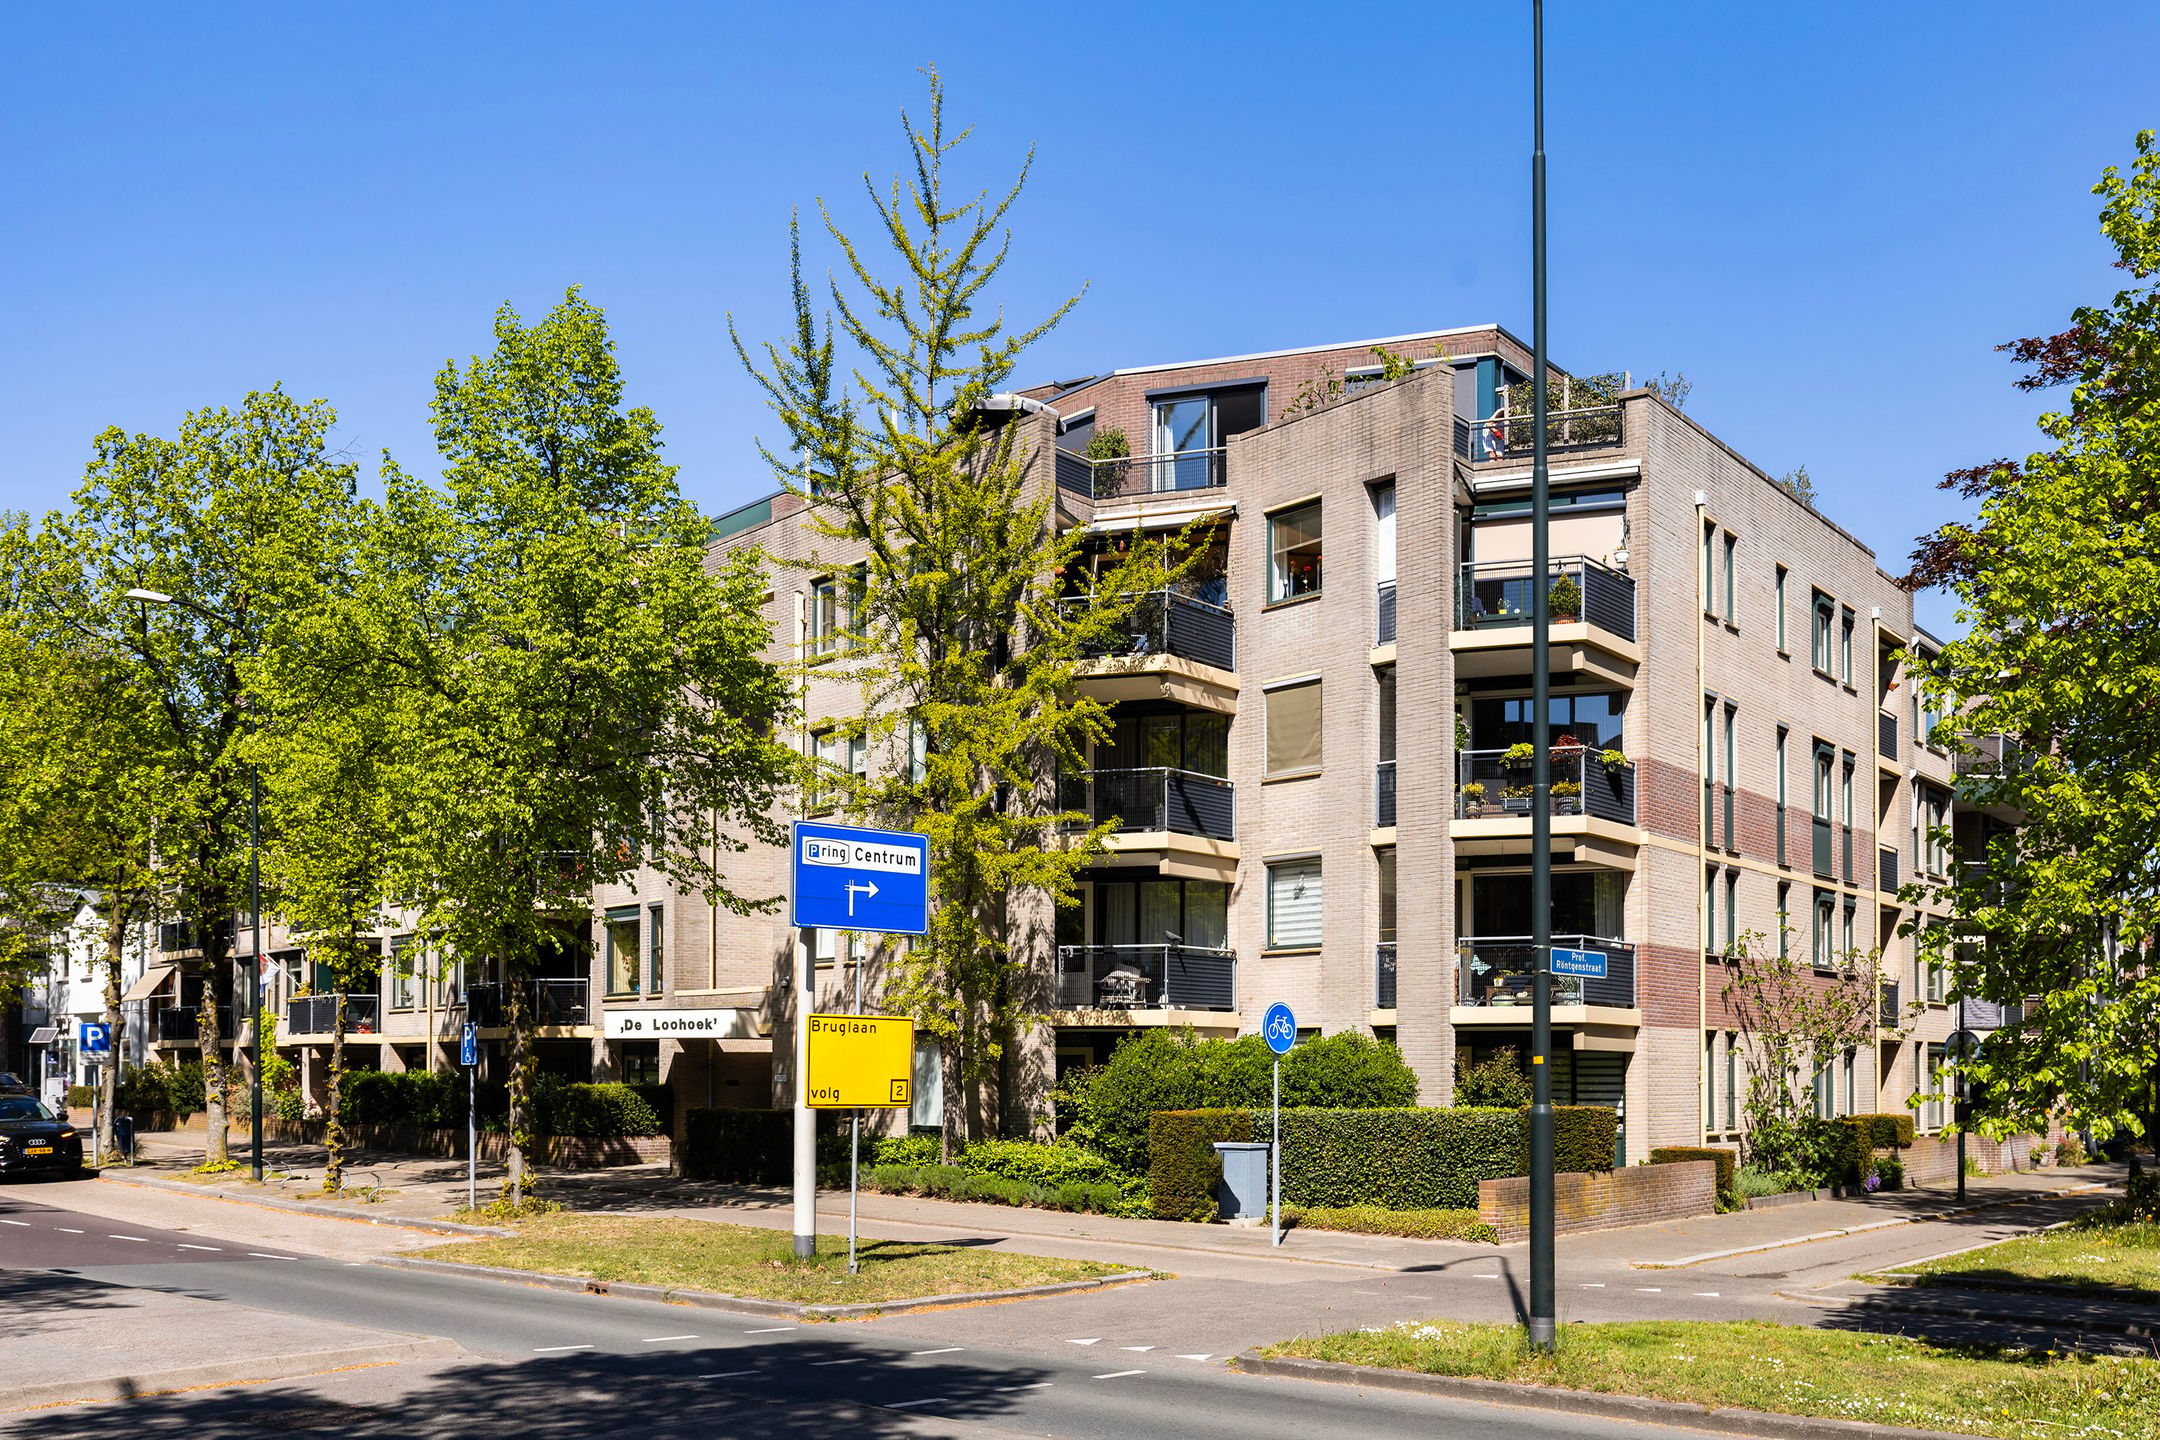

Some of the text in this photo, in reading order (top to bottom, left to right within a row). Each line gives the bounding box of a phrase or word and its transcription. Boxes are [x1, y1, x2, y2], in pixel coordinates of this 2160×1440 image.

[811, 845, 916, 867] P ring Centrum
[1571, 953, 1586, 962] Prof.
[1556, 960, 1601, 973] Röntgenstraat
[812, 1020, 876, 1036] Bruglaan
[86, 1026, 104, 1048] P
[464, 1026, 472, 1048] P
[811, 1087, 840, 1102] volg
[896, 1085, 903, 1096] 2
